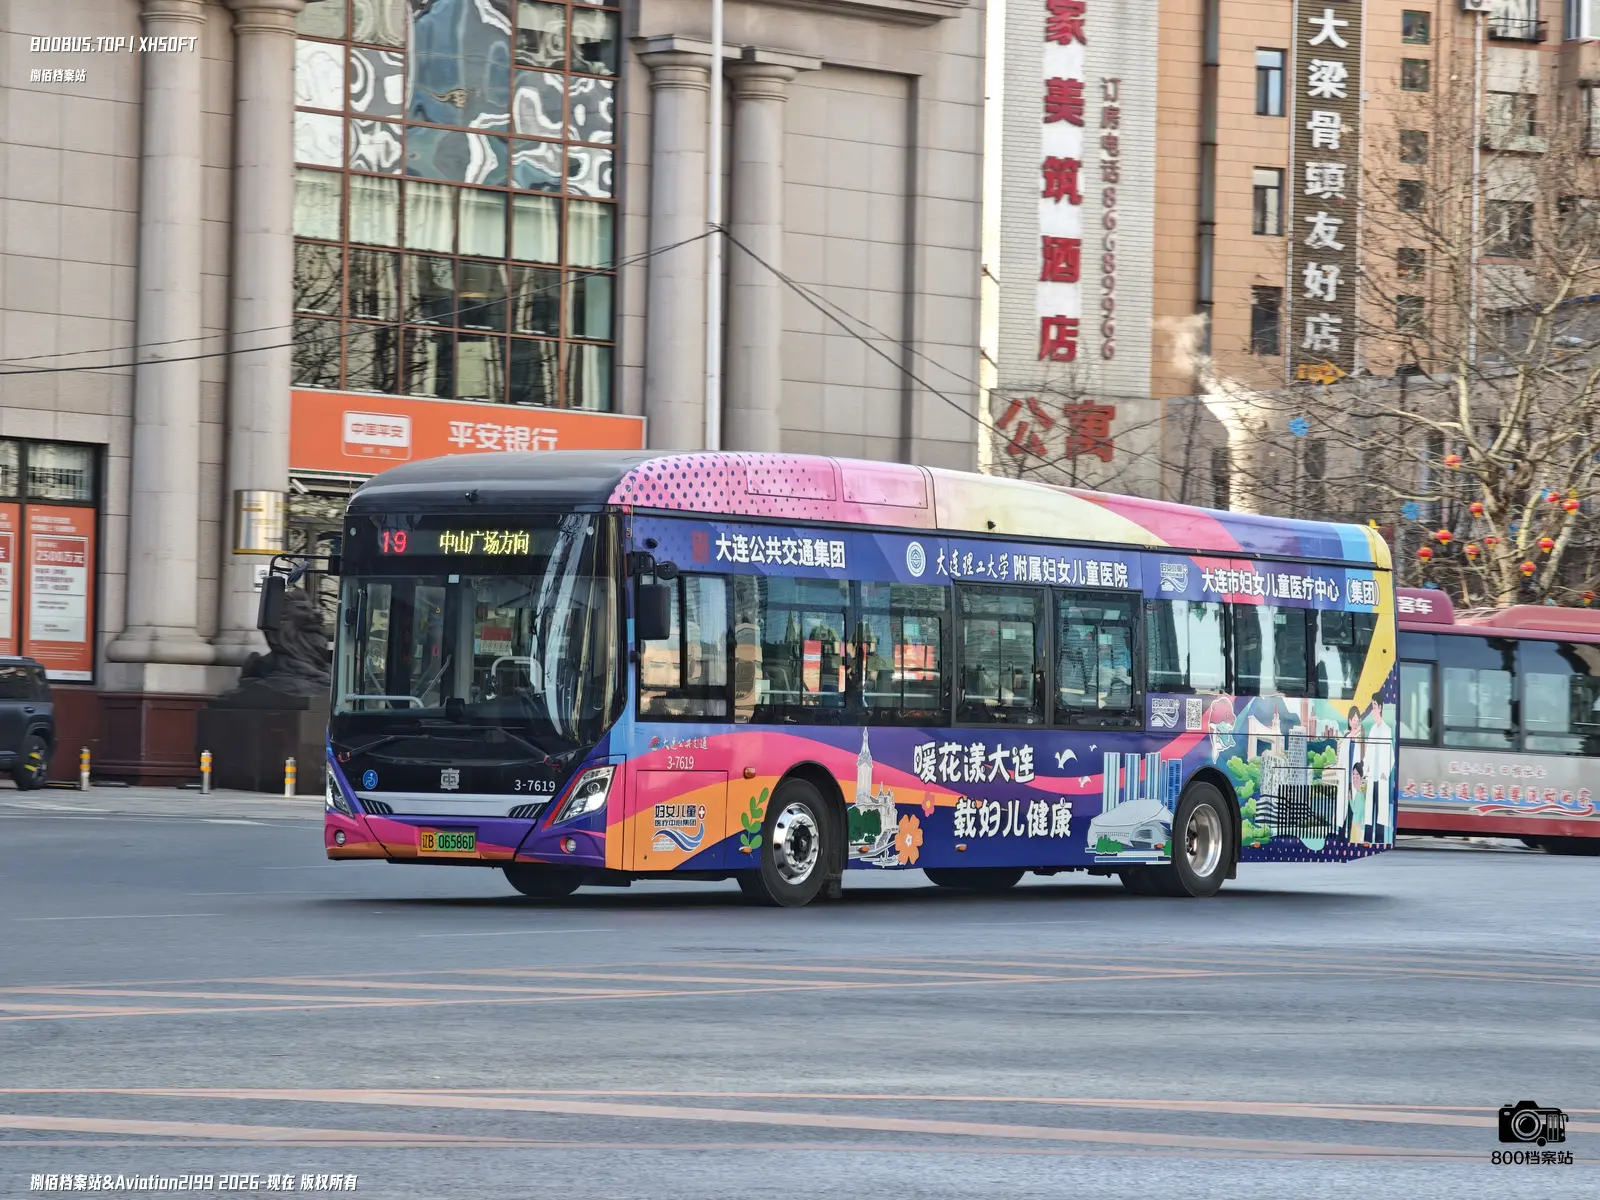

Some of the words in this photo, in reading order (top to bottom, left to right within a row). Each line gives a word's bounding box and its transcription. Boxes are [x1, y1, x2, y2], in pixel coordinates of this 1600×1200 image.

[351, 422, 403, 438] 中国平安
[447, 420, 558, 452] 平安银行
[996, 397, 1116, 463] 公寓
[383, 531, 407, 553] 19
[439, 530, 530, 555] 中山广场方向
[715, 533, 847, 569] 大连公共交通集团
[1397, 596, 1433, 614] 客车
[667, 755, 695, 770] 3-7619
[913, 741, 1036, 784] 暖花漾大连
[514, 779, 556, 792] 3-7619
[655, 804, 697, 818] 妇女儿童
[438, 834, 474, 850] 06586D
